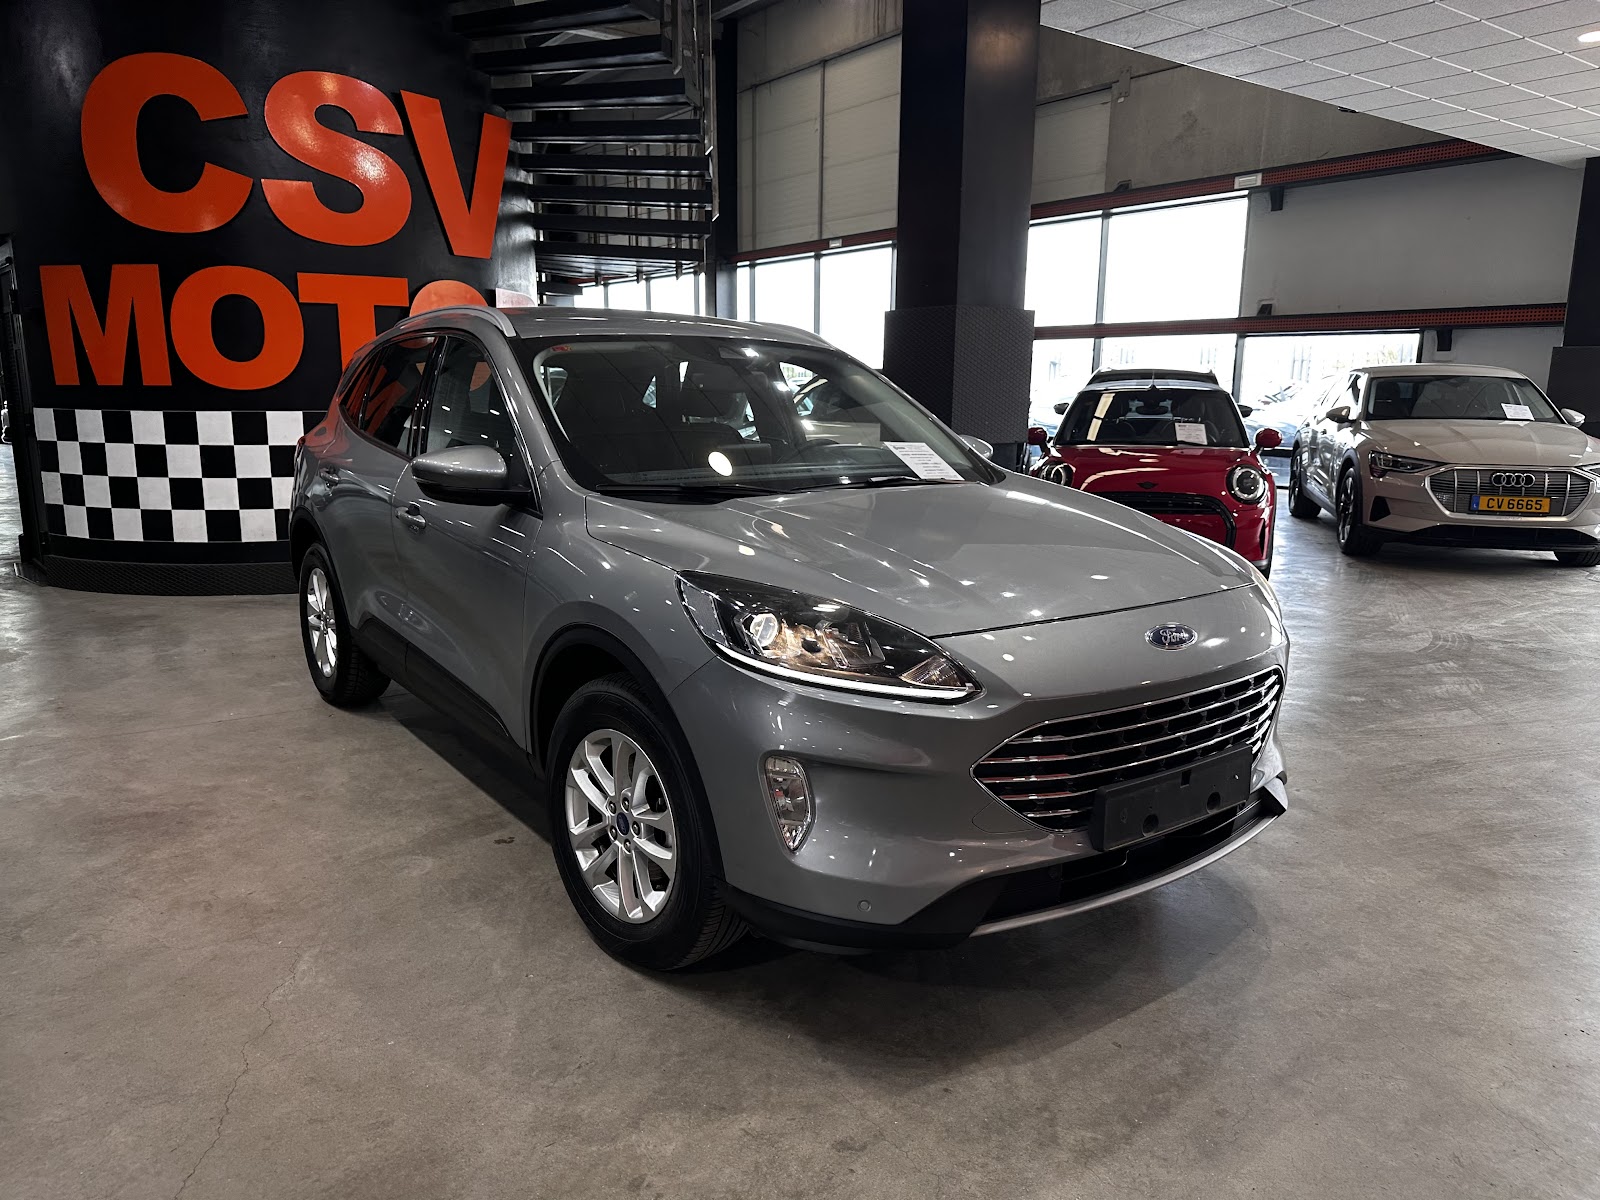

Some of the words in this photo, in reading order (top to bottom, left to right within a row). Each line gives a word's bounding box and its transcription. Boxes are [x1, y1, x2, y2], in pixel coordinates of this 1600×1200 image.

[81, 52, 512, 259] CSV
[39, 264, 538, 391] MOT
[1487, 497, 1505, 509] CV
[1507, 498, 1543, 510] 6665
[1160, 628, 1189, 644] Ford
